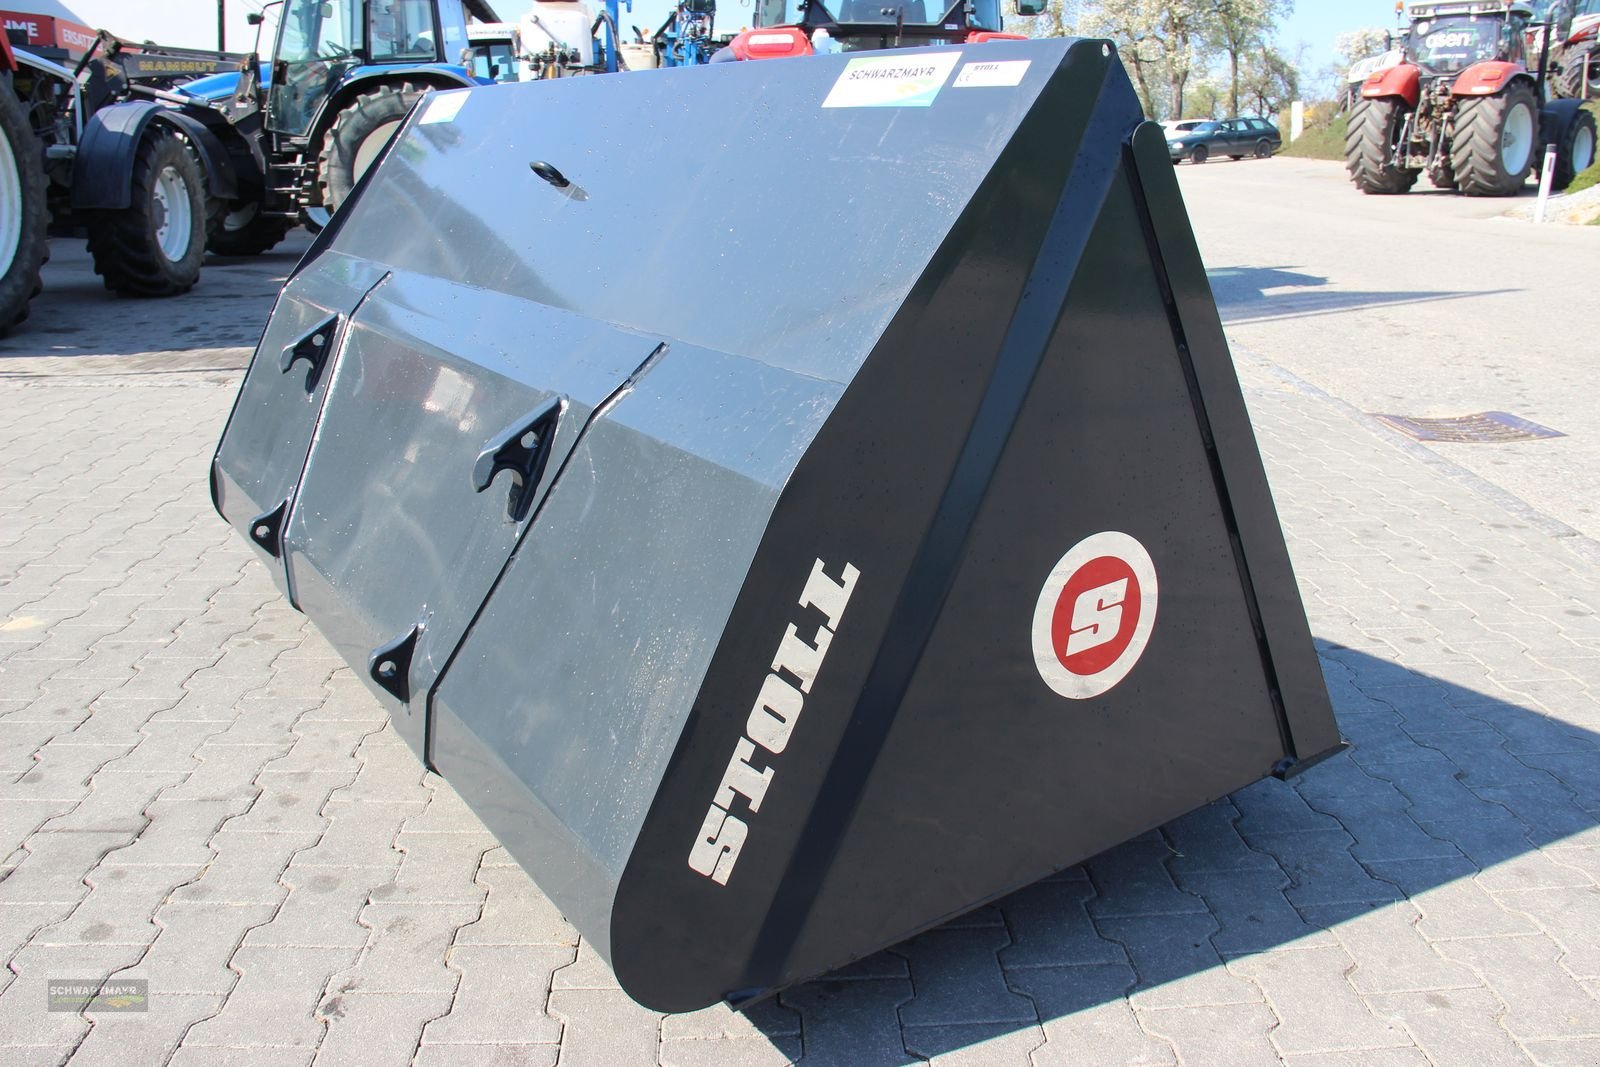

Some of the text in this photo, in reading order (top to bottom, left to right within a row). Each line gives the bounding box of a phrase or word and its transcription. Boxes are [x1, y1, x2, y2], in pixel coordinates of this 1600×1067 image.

[139, 61, 216, 71] MAMMUT
[849, 66, 936, 80] SCHWARZMAYR
[688, 557, 861, 886] STOLL
